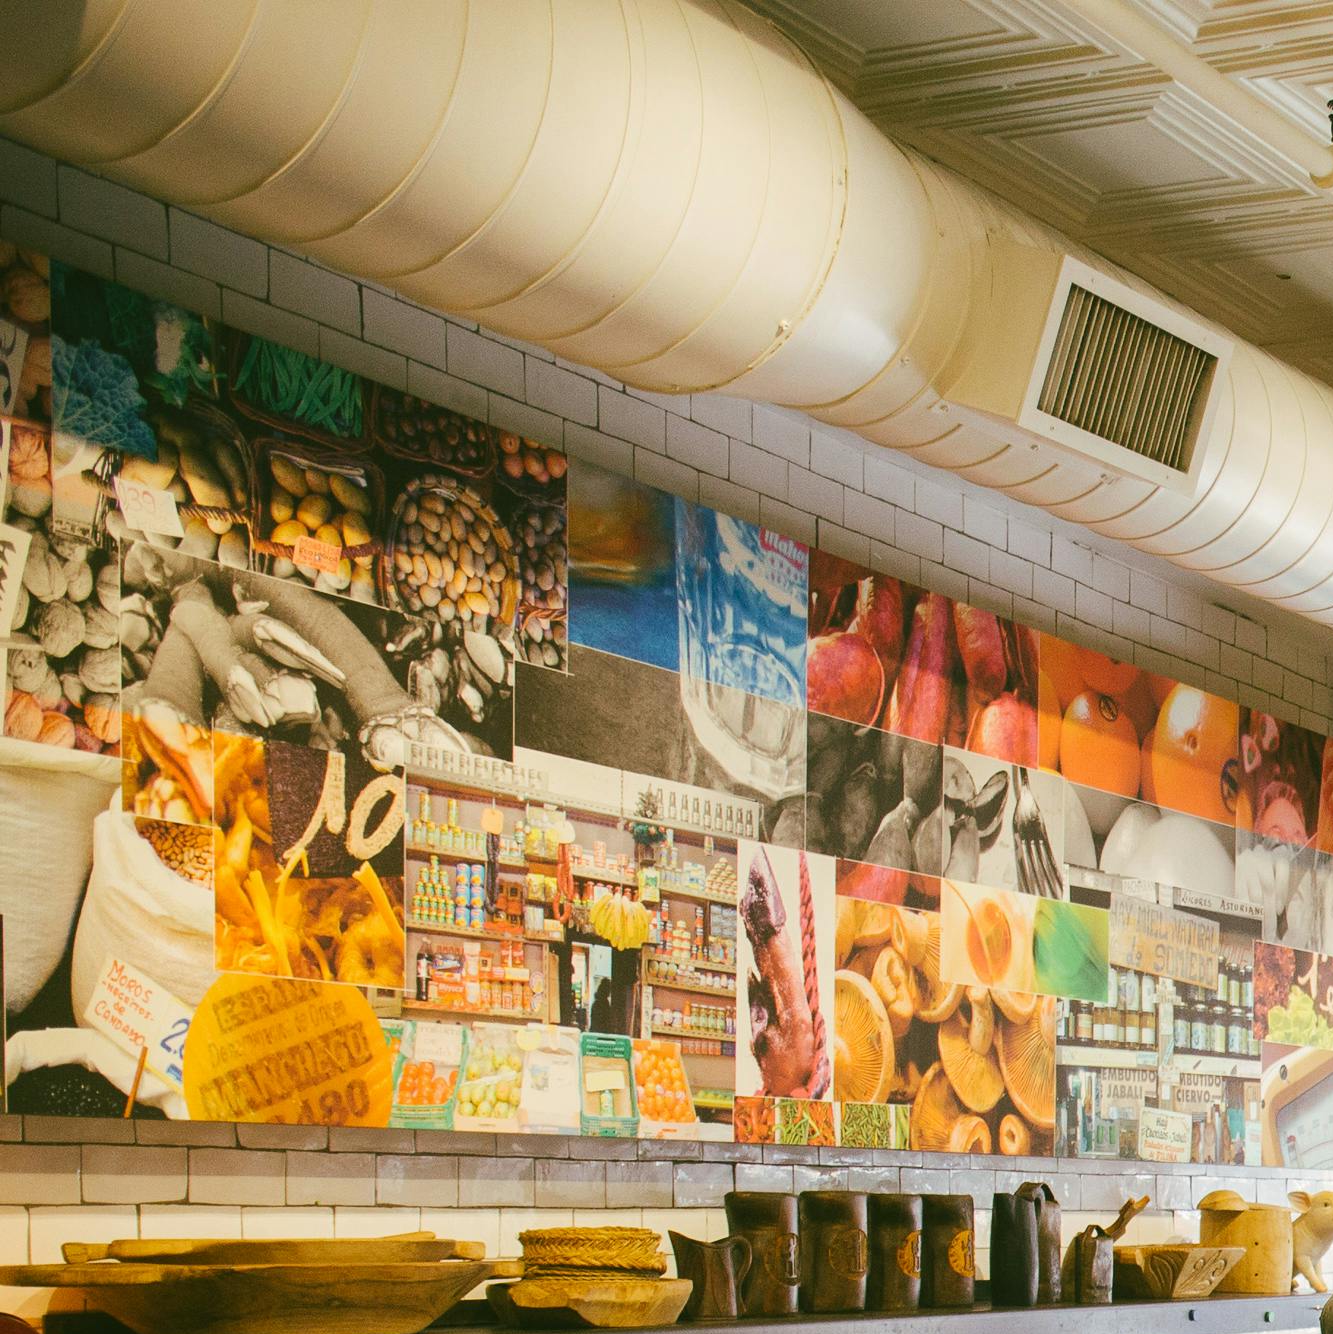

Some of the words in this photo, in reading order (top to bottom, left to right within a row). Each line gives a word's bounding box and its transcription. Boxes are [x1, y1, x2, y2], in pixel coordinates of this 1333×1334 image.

[106, 959, 153, 1004] MOROS
[1101, 1068, 1157, 1084] EMBUTIDO
[1176, 1090, 1212, 1105] CIERVO
